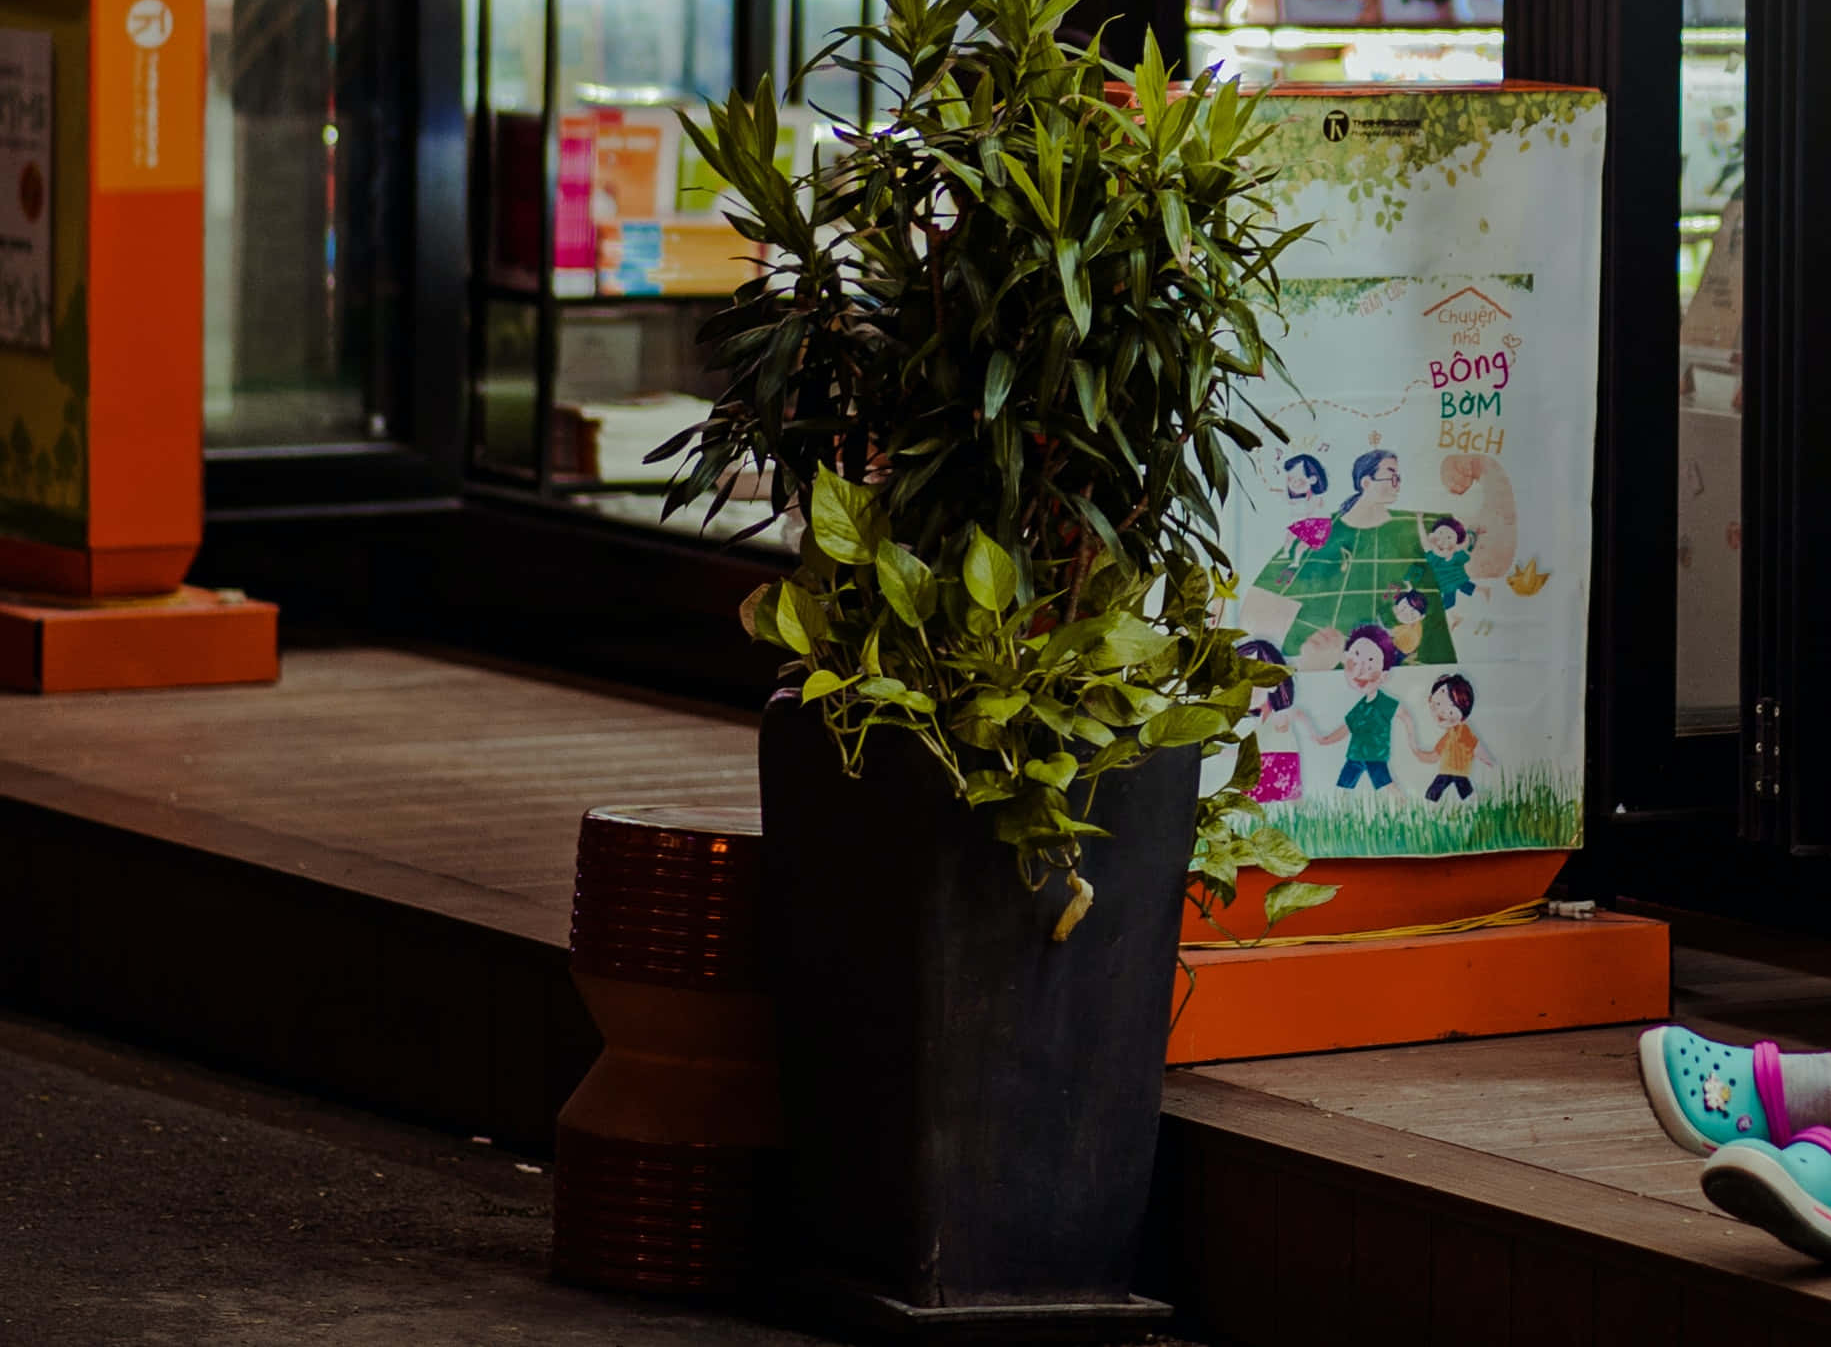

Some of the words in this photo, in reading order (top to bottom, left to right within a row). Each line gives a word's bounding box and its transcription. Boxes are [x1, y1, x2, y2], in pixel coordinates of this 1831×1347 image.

[1437, 305, 1497, 331] Chuyện
[1452, 327, 1481, 346] nhà
[1429, 350, 1509, 389] Bông
